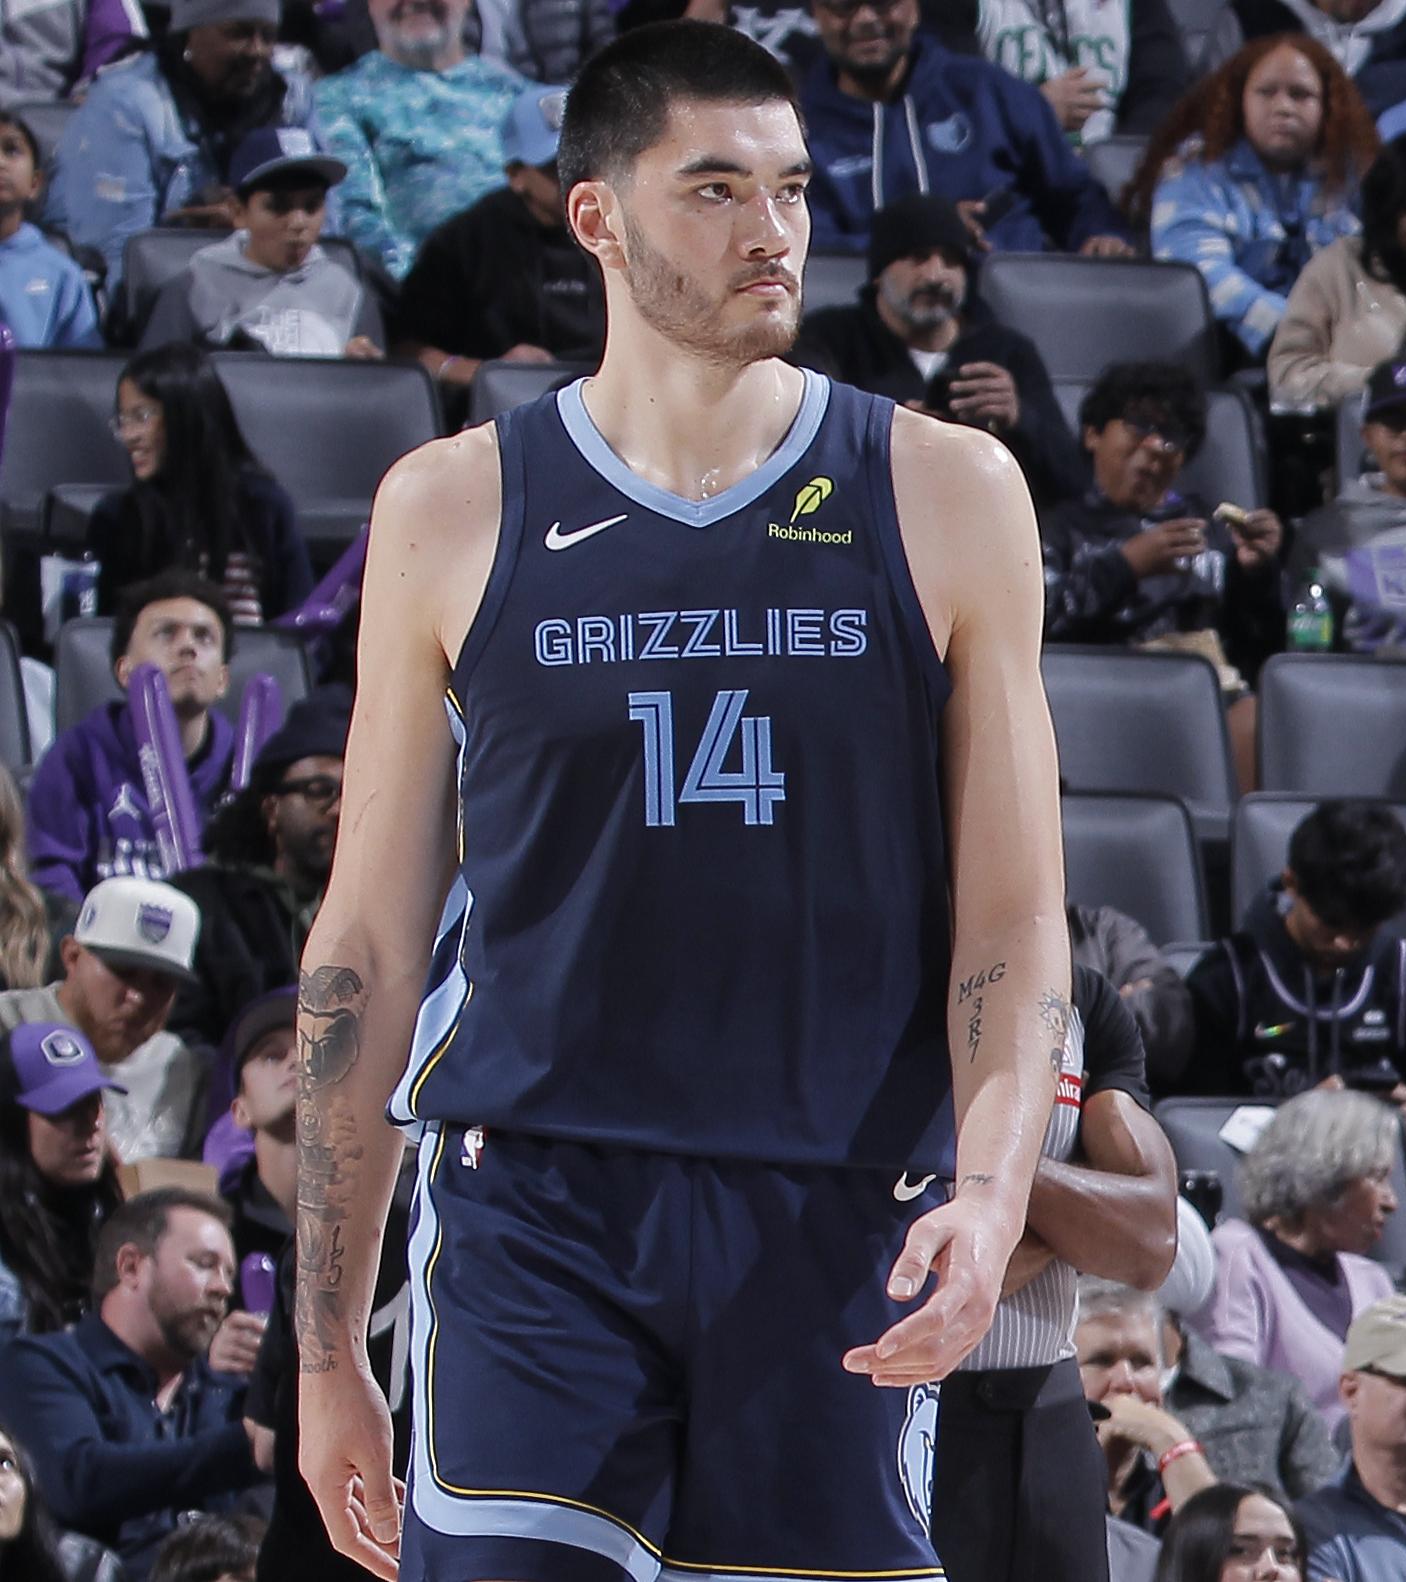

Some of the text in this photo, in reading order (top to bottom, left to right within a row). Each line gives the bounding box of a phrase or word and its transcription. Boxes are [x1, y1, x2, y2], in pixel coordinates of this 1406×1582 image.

[768, 523, 852, 544] Robinhood
[534, 608, 868, 667] GRIZZLIES
[627, 689, 786, 827] 14
